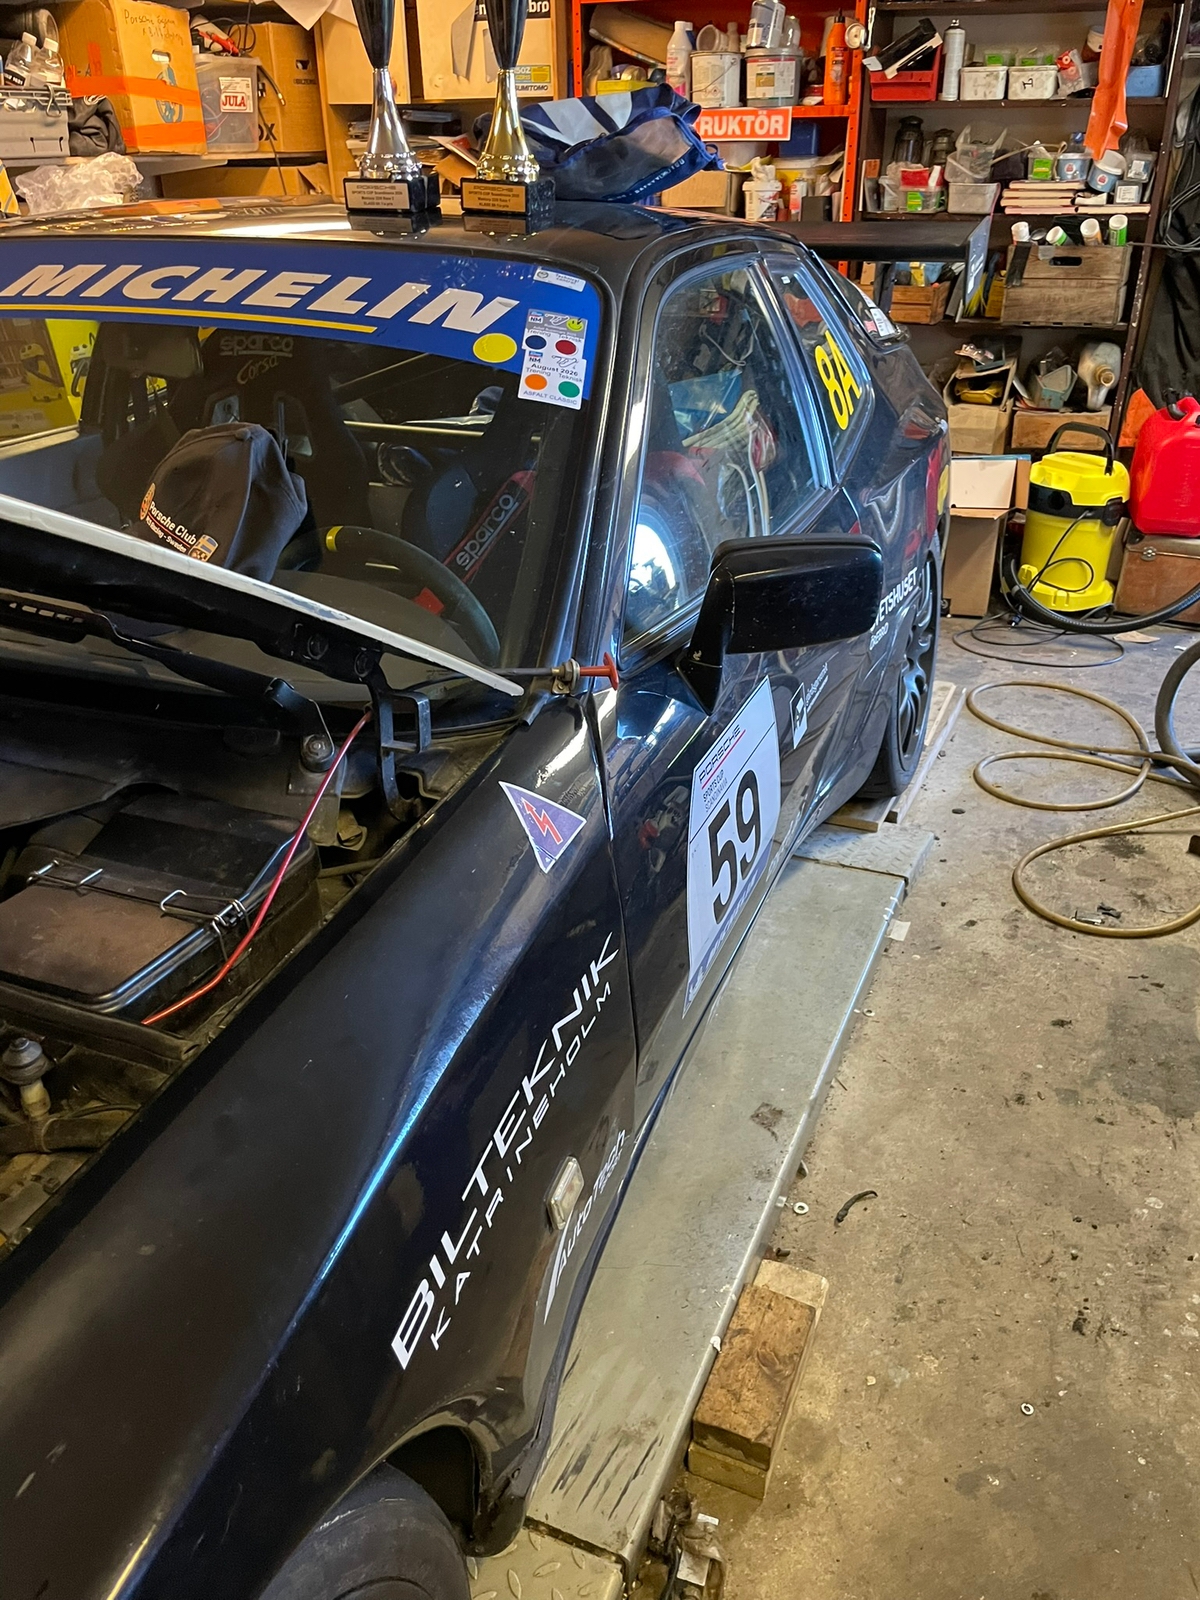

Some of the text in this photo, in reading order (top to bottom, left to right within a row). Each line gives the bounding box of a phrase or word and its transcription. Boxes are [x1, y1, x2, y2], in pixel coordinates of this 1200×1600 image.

[222, 95, 246, 107] JULA
[701, 111, 785, 136] RUKTÖR
[473, 185, 514, 193] PORSCHE
[0, 264, 520, 334] MICHELIN
[220, 335, 294, 356] sparco
[237, 355, 278, 385] Corsa
[531, 363, 579, 377] August 2026
[814, 330, 863, 431] 8A
[523, 390, 578, 406] ASFALT CLASSIC
[149, 501, 176, 532] Porsche
[175, 524, 198, 546] Club
[456, 494, 514, 567] sparco
[698, 723, 741, 784] PORSCHE
[702, 768, 725, 803] SPORTS CUP
[707, 769, 761, 925] 59
[391, 931, 619, 1371] BILTEKNIK
[430, 981, 612, 1351] KATRINEHOLM
